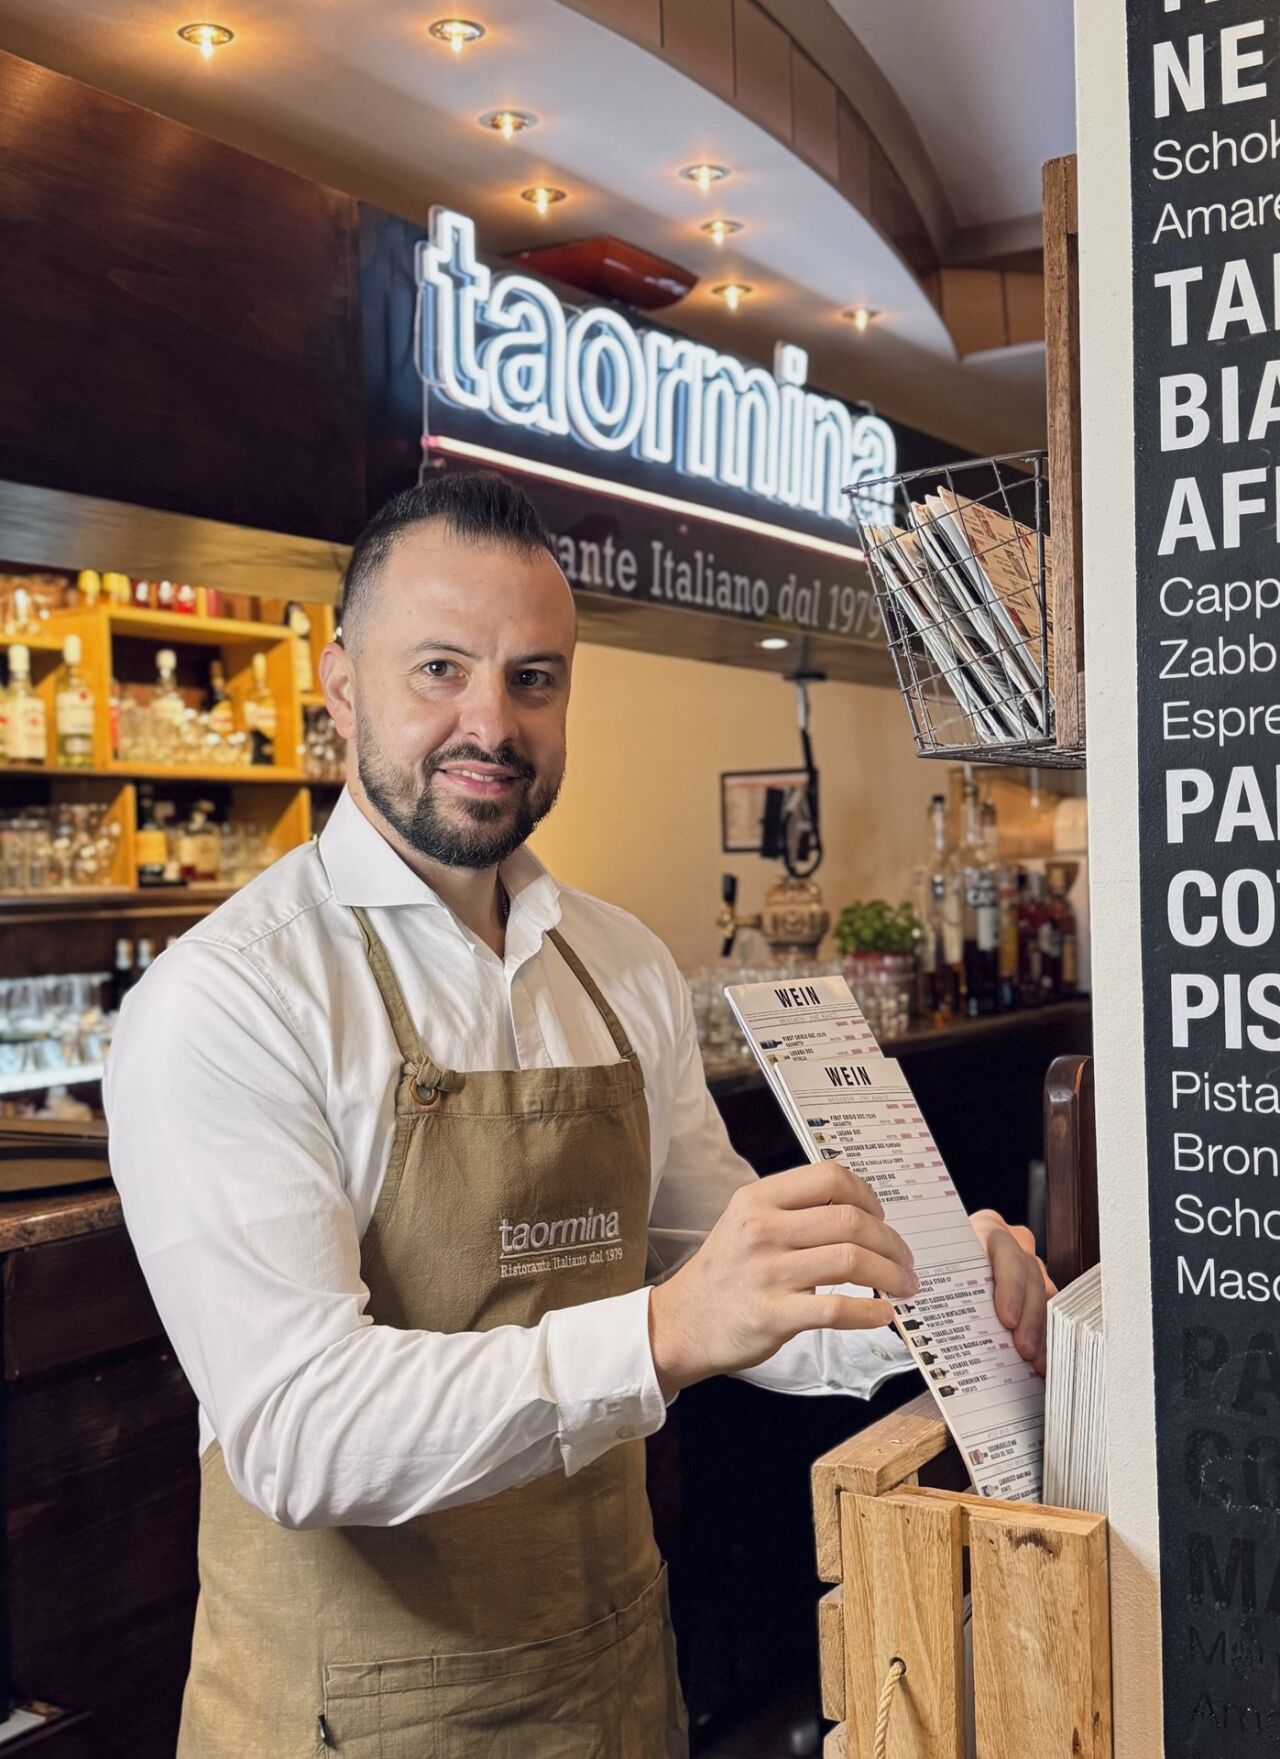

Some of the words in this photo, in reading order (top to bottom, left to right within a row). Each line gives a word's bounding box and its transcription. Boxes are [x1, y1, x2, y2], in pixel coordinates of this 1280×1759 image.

[1154, 252, 1280, 347] TA
[417, 205, 897, 528] taormina
[1157, 466, 1280, 556] AF
[650, 541, 770, 616] Italiano
[777, 573, 821, 628] dal
[828, 584, 884, 639] 1979
[1159, 576, 1280, 621] Capp
[1159, 633, 1278, 680] Zabb
[1166, 764, 1280, 844] PA
[1167, 868, 1280, 948] CO
[774, 986, 821, 1008] WEIN
[824, 1066, 872, 1087] WEIN
[1171, 1071, 1280, 1114] Pista
[1173, 1133, 1279, 1177] Bron
[499, 1207, 620, 1252] taormina
[500, 1260, 551, 1278] Ristorante
[553, 1255, 587, 1270] Italiano
[589, 1251, 604, 1264] dal
[606, 1247, 624, 1262] 1979
